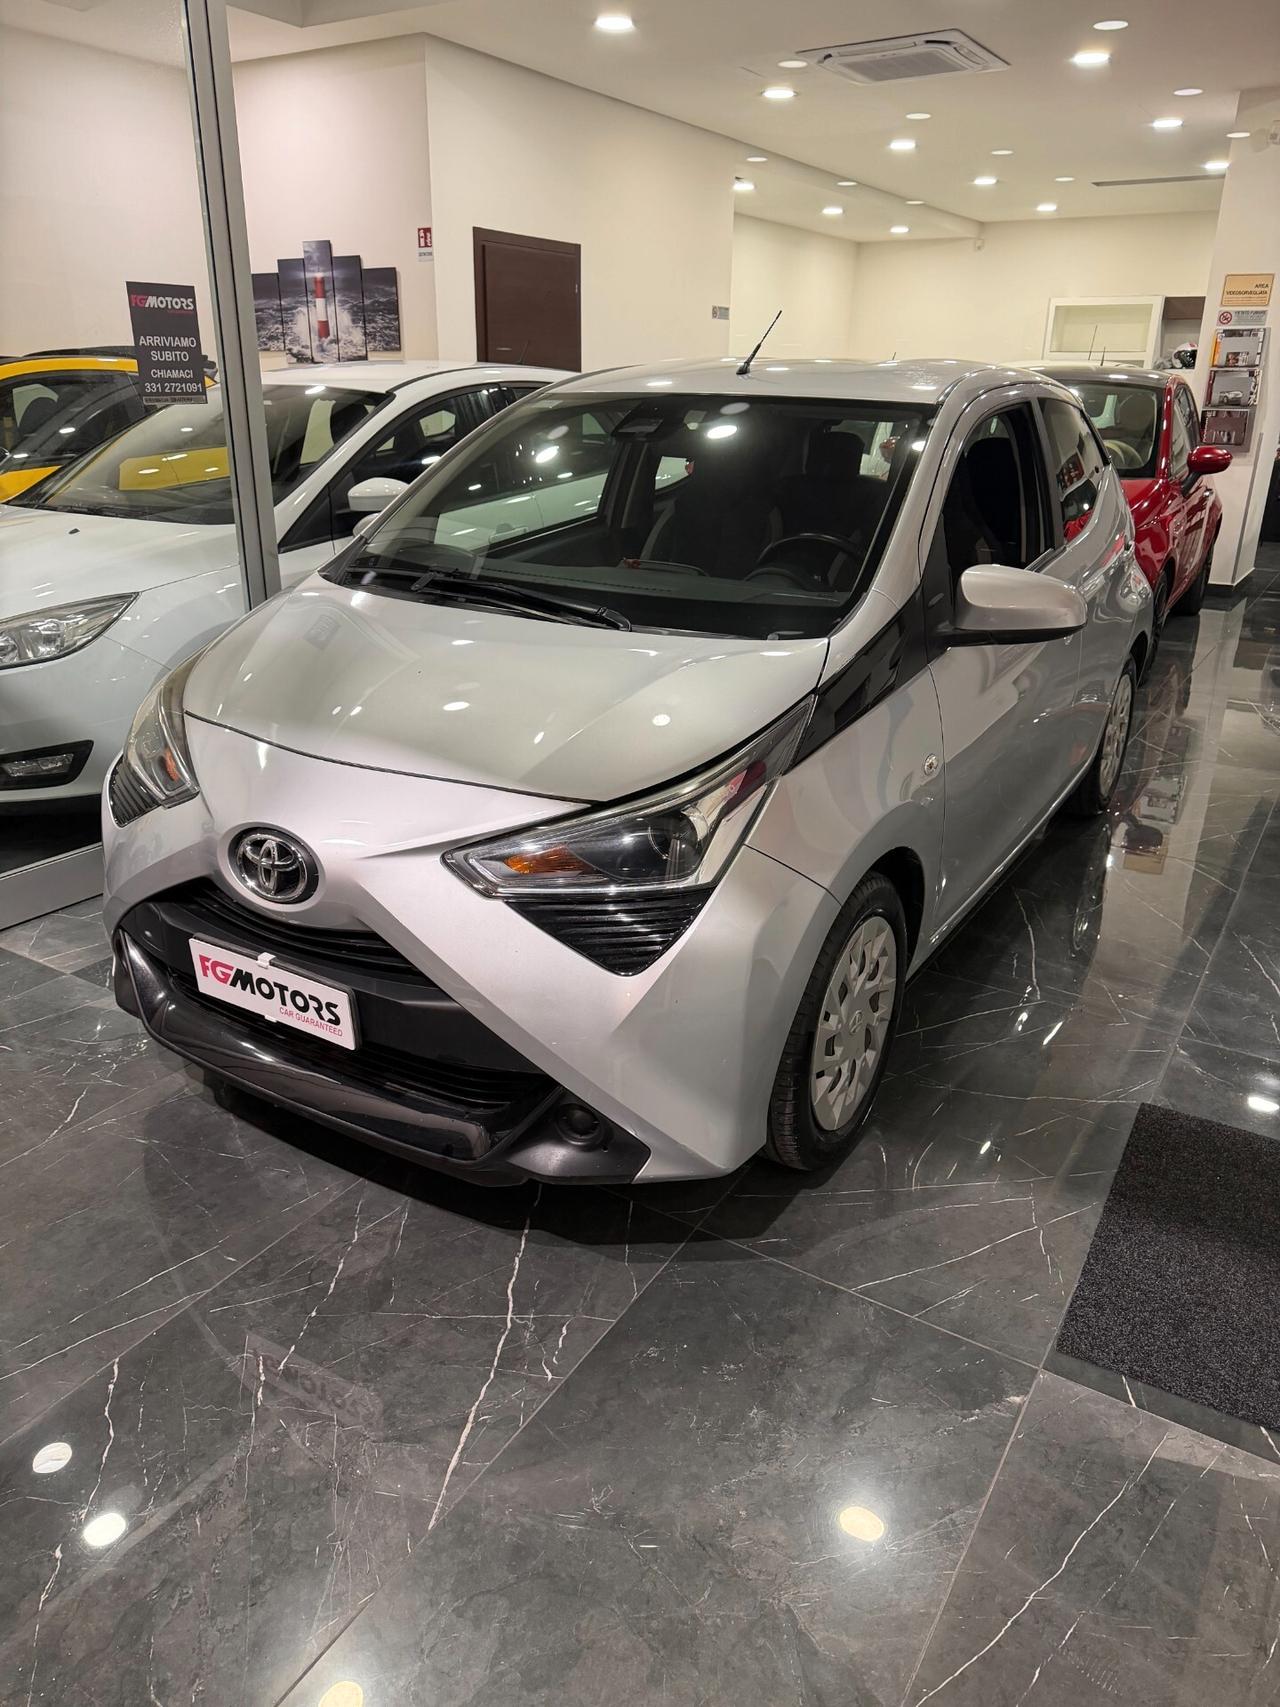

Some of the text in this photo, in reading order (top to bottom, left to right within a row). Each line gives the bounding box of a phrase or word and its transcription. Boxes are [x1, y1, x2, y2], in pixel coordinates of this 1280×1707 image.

[139, 335, 197, 348] ARRIVIAMO
[150, 350, 190, 362] SUBITO
[150, 369, 194, 379] CHIAMACI
[144, 382, 203, 393] 331 2721091
[198, 954, 342, 1026] FGMOTORS
[279, 1006, 343, 1037] CAR GUARANTEED
